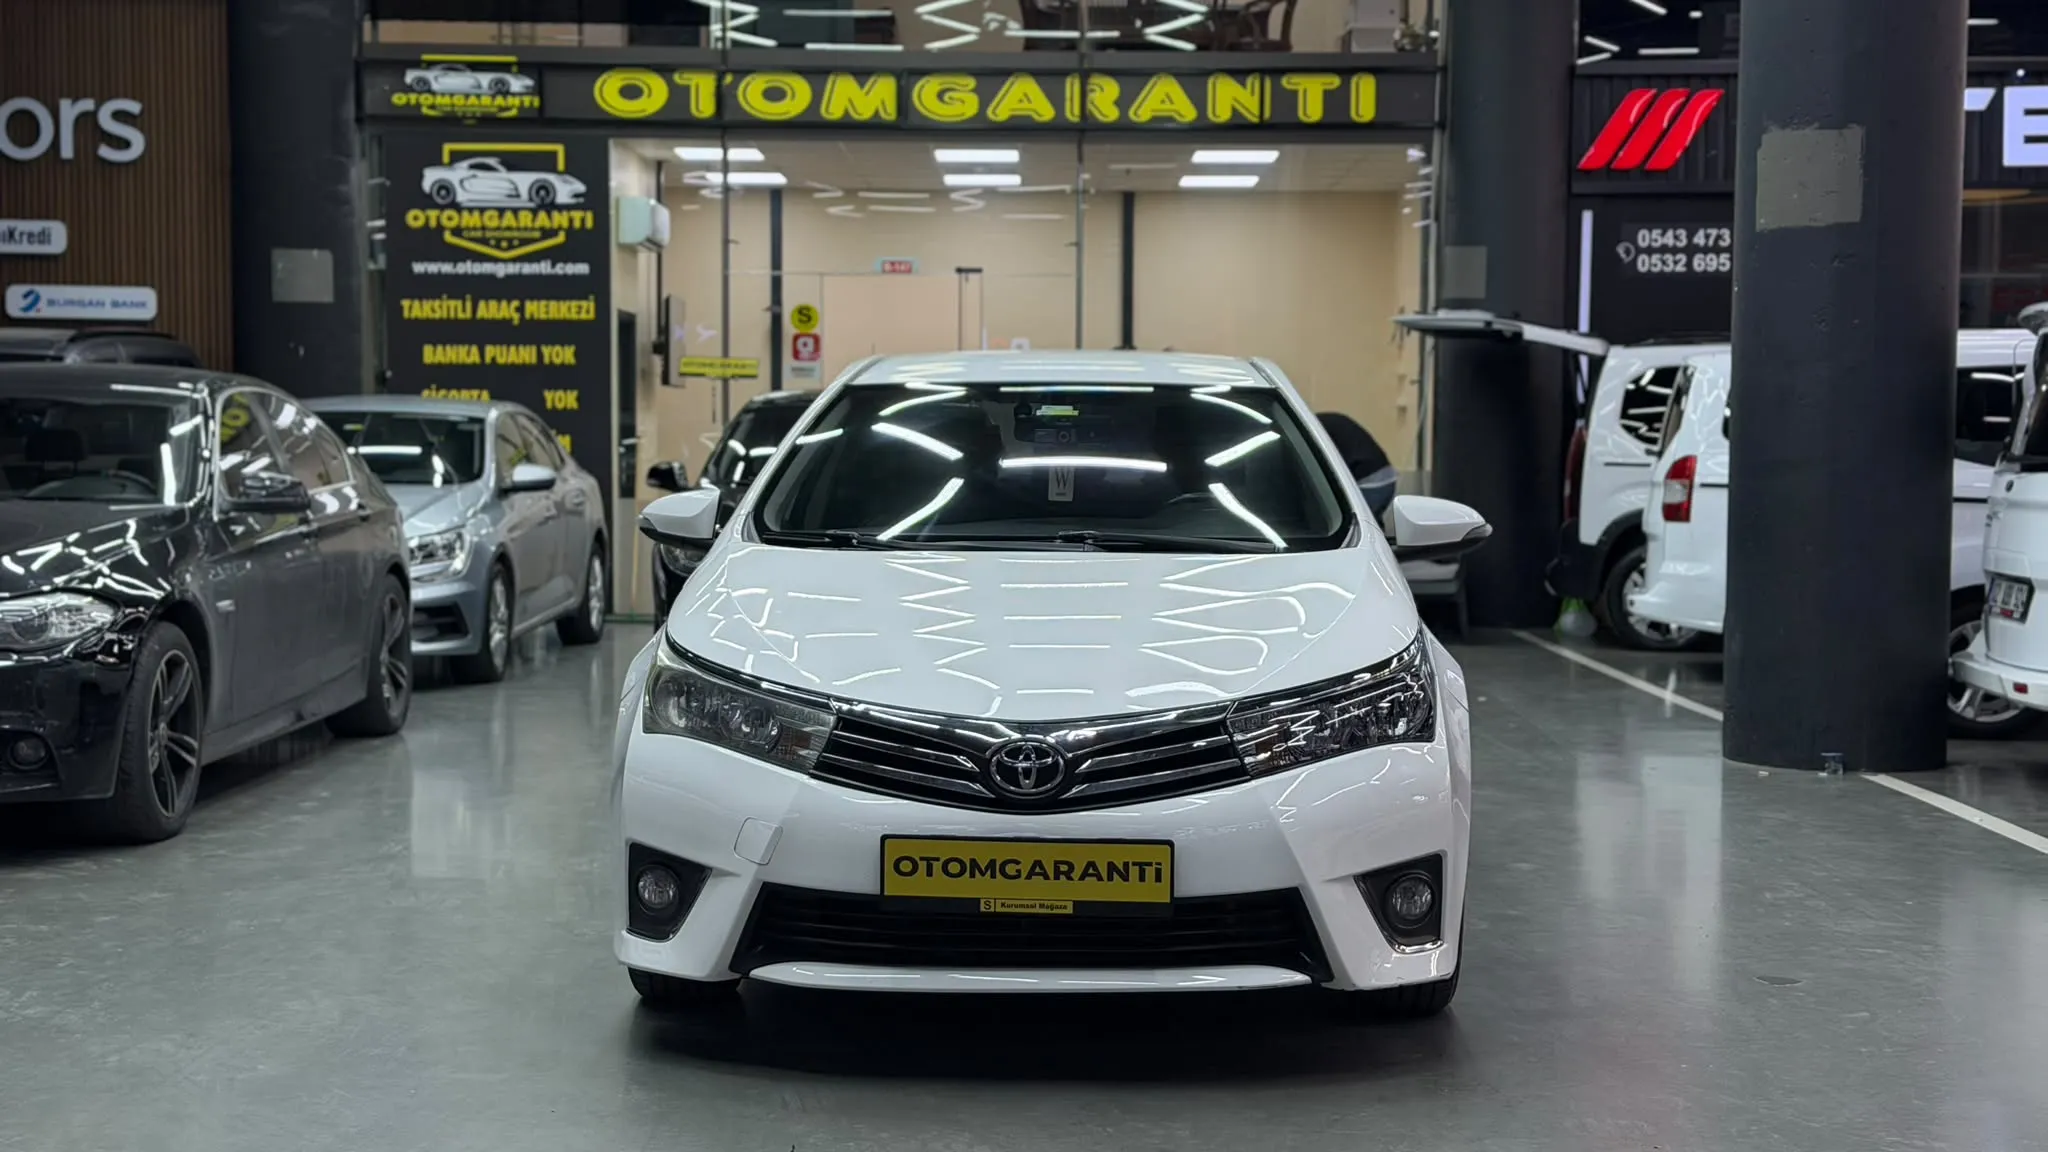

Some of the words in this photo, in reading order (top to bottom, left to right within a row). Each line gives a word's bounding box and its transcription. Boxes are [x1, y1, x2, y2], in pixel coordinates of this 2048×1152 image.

[593, 67, 1377, 124] OTOMGARANTI
[0, 96, 147, 164] ors
[405, 208, 595, 230] OTOMGARANTI
[0, 224, 53, 245] ıKredi
[1636, 228, 1688, 248] 0543
[1692, 228, 1731, 248] 473
[411, 259, 590, 278] www.otomgaranti.com
[1636, 253, 1687, 273] 0532
[1692, 253, 1731, 273] 695
[401, 294, 473, 320] TAKSİTLİ
[475, 299, 521, 325] ARAÇ
[524, 294, 597, 321] MERKEZİ
[422, 344, 482, 365] BANKA
[484, 344, 538, 365] PUANI
[540, 344, 577, 366] YOK
[542, 388, 579, 410] YOK
[1000, 901, 1037, 910] Kurumsal
